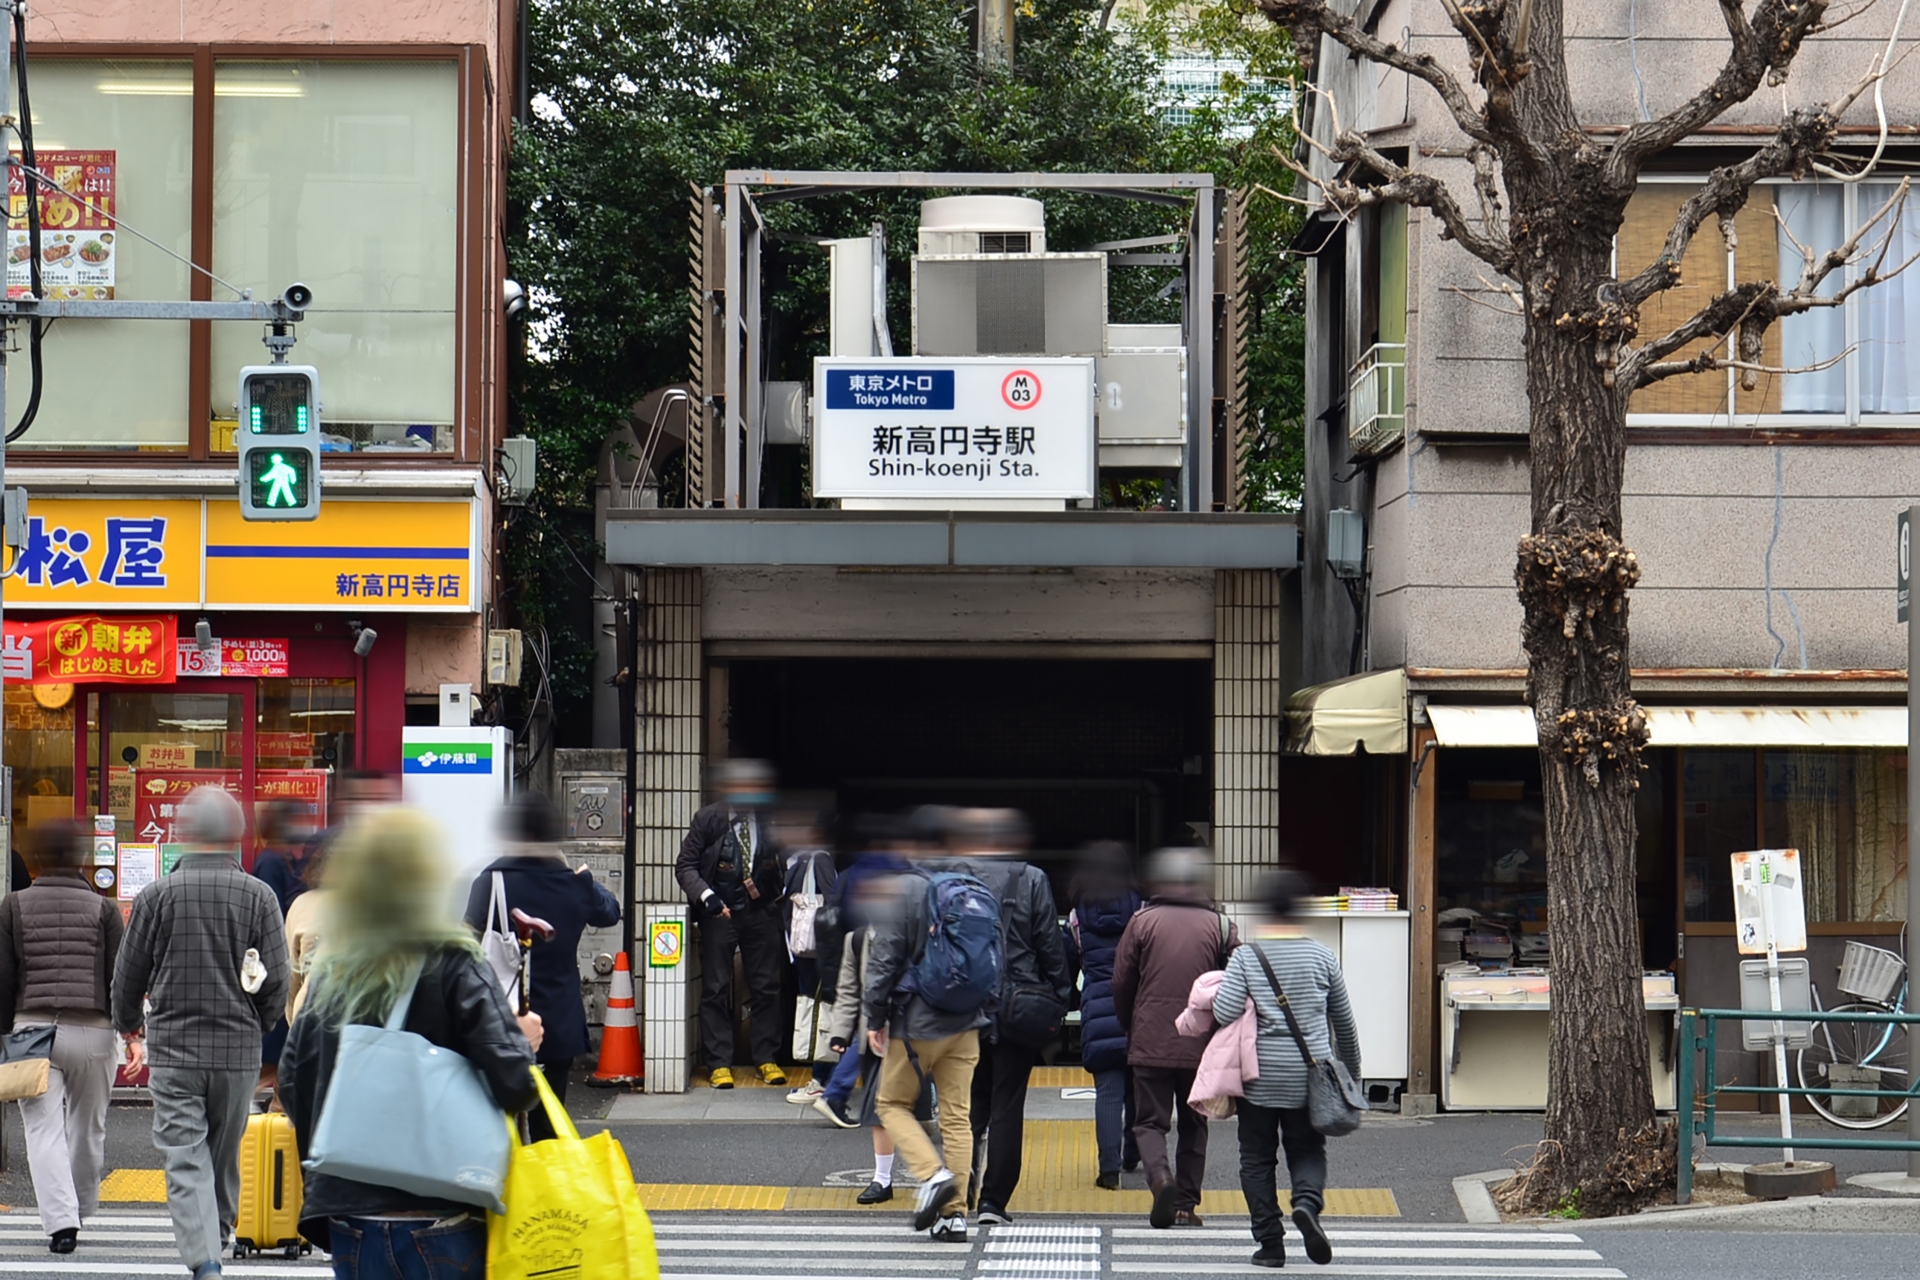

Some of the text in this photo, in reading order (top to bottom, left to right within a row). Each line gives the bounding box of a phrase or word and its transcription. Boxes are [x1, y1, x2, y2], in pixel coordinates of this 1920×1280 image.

[849, 375, 932, 391] 東京メトロ
[1015, 377, 1028, 388] M
[854, 394, 927, 408] Tokyo Metro
[1012, 390, 1031, 402] 03
[872, 425, 1036, 456] 新高円寺駅
[869, 458, 1040, 482] Shin-koenji Sta.
[15, 516, 168, 588] 松屋
[336, 573, 460, 598] 新高円寺店
[60, 657, 157, 675] はじめました
[150, 748, 186, 760] お弁当
[146, 761, 189, 769] コーナー
[513, 1208, 588, 1239] HANAMASA
